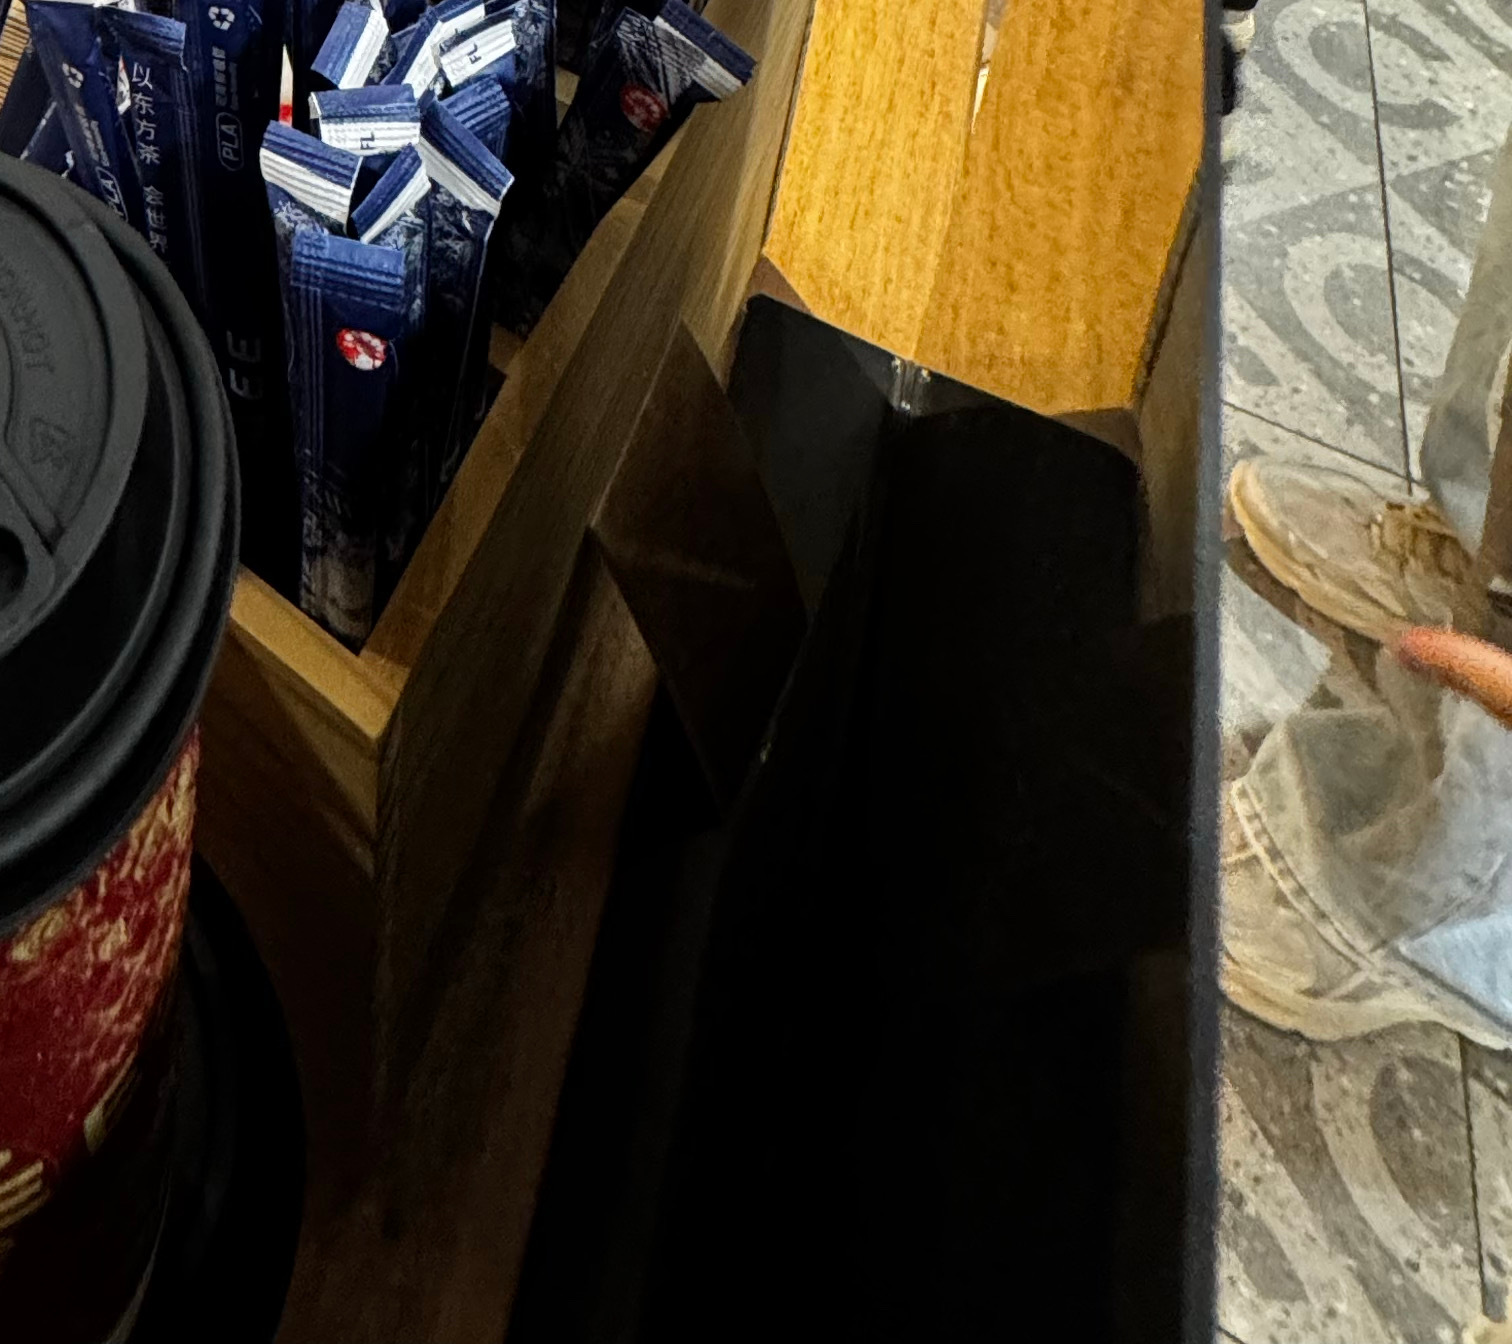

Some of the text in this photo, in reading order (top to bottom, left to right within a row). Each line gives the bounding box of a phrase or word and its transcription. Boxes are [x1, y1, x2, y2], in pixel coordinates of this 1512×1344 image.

[468, 43, 483, 65] FL
[131, 62, 161, 165] 以东方茶
[219, 123, 240, 162] PLA
[359, 132, 376, 151] FL
